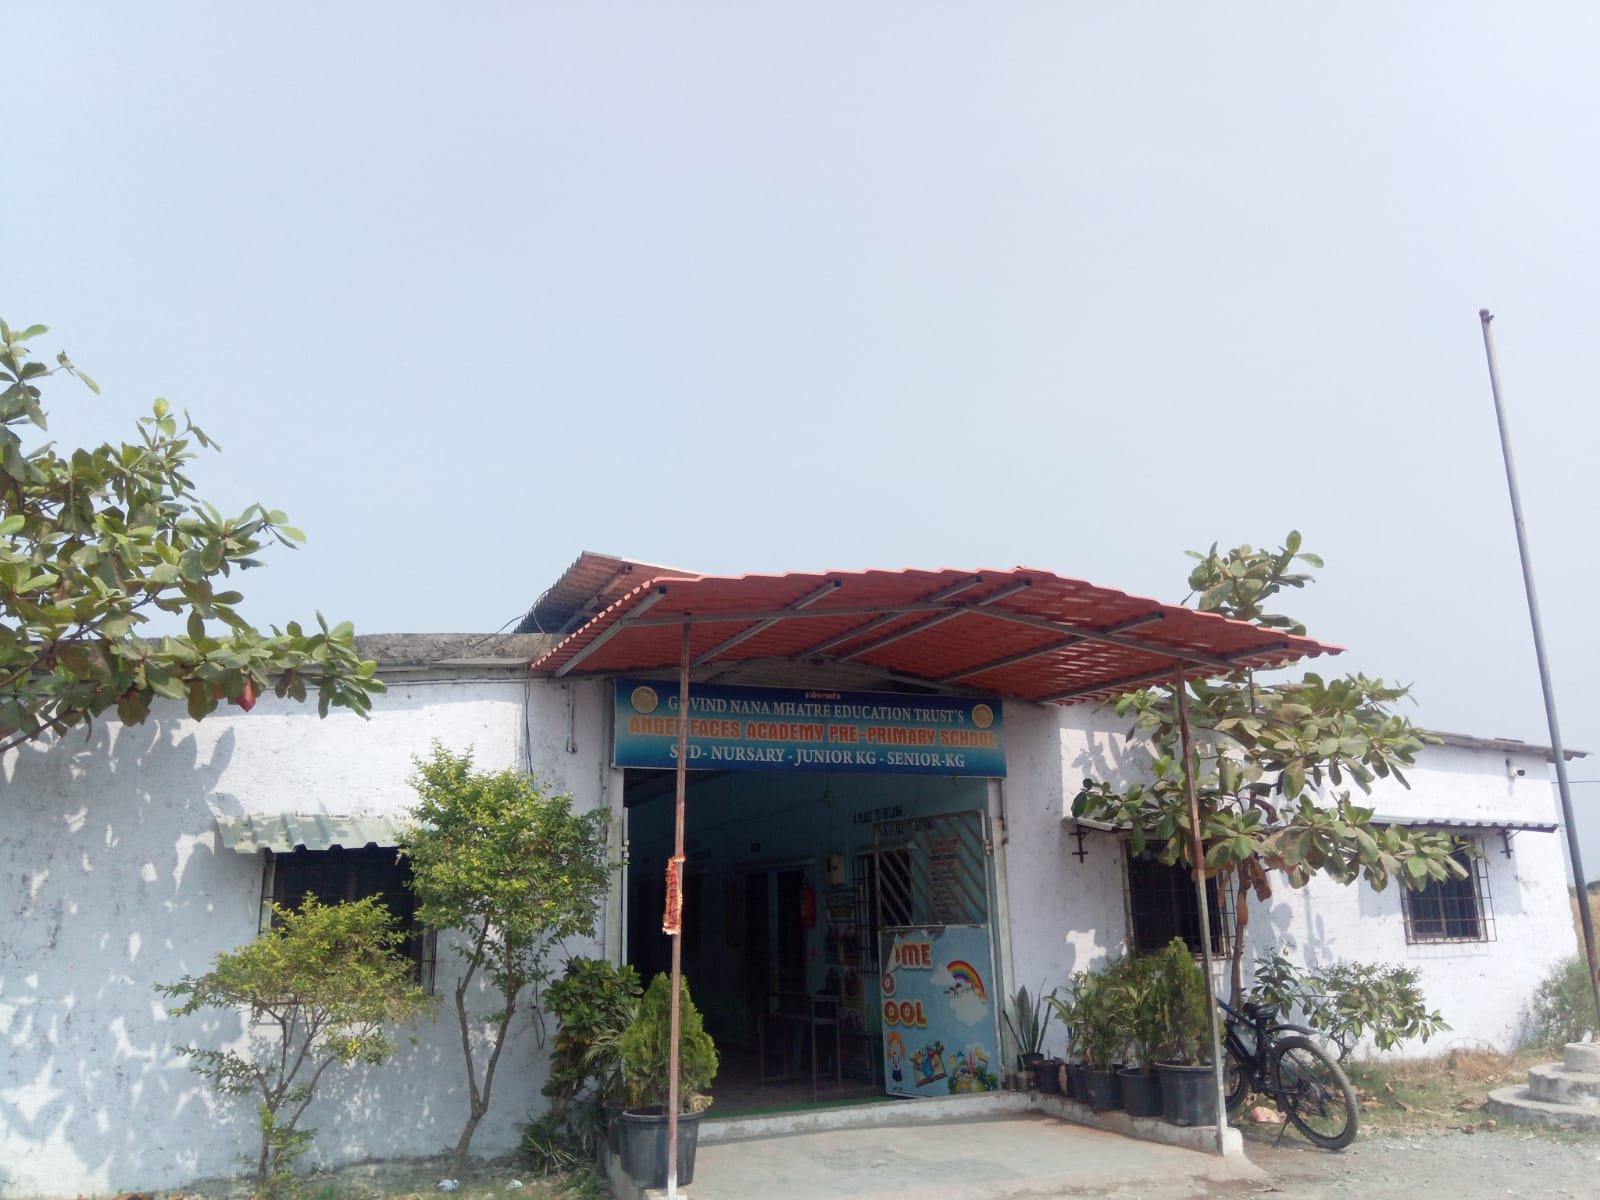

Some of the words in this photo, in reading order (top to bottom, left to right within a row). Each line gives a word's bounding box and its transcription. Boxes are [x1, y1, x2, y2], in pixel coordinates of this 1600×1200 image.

[668, 696, 726, 713] GVIND
[730, 699, 770, 714] NANA
[773, 702, 831, 718] MHATRE
[834, 705, 911, 720] EDUCATION
[914, 708, 964, 724] TRUST'S
[689, 718, 741, 739] FACES
[747, 721, 824, 742] ACADEMY
[828, 724, 936, 746] PRE-PRIMARY
[941, 729, 998, 749] SCHOOL
[669, 744, 707, 759] SD-
[711, 745, 786, 762] NURSARY
[795, 749, 853, 767] JUNIOR
[856, 751, 876, 765] KG
[887, 752, 965, 767] SENIOR-KG
